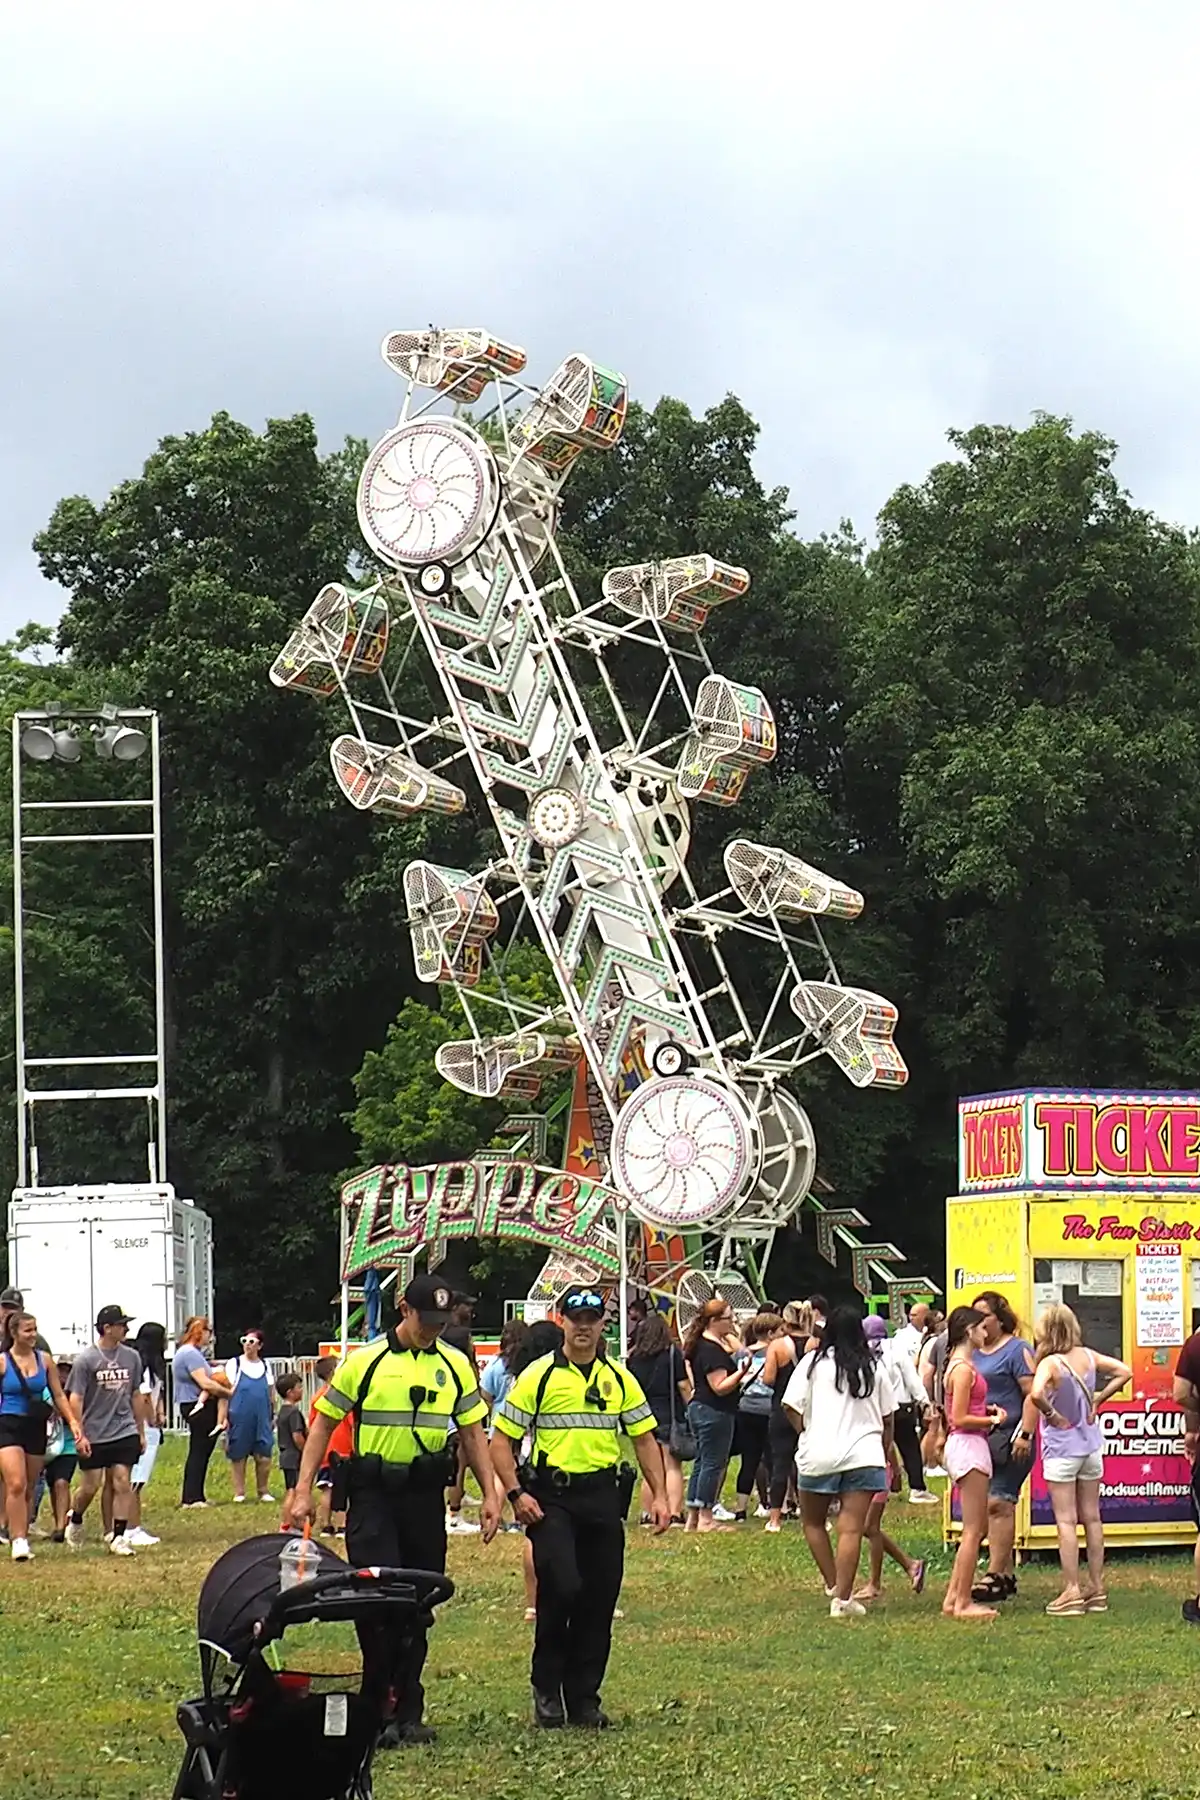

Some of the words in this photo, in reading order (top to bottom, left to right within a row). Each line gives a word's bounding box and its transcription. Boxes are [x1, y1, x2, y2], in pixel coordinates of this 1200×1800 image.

[963, 1105, 1023, 1181] TICKETS
[341, 1160, 630, 1280] Zipper
[1063, 1215, 1095, 1240] The
[1096, 1216, 1137, 1240] Fun
[1138, 1216, 1193, 1241] Starts
[113, 1238, 148, 1248] SILENCER
[1138, 1244, 1180, 1255] TICKETS
[96, 1368, 130, 1381] STATE
